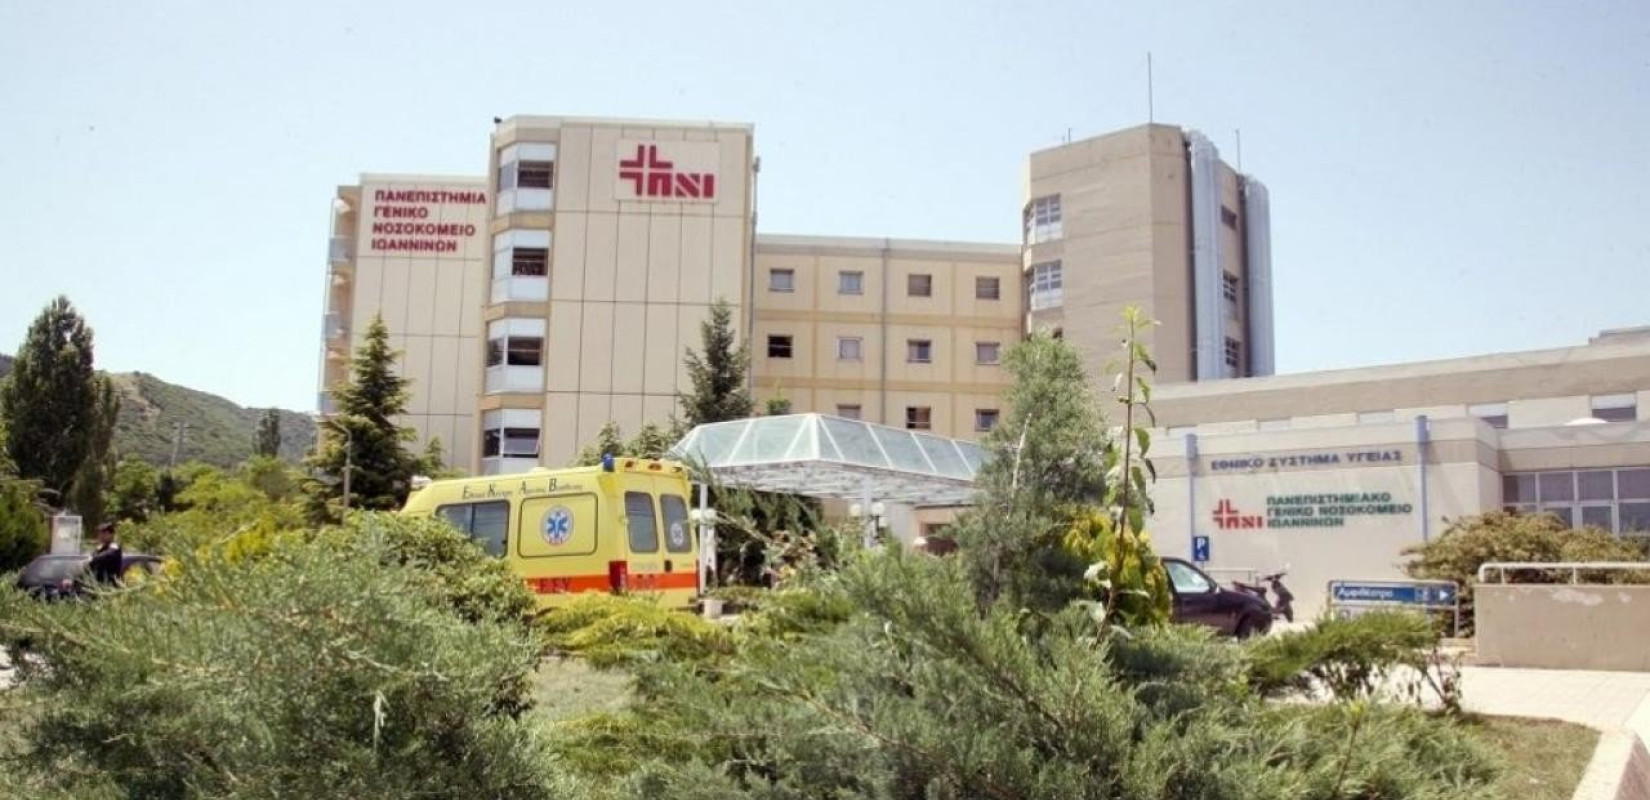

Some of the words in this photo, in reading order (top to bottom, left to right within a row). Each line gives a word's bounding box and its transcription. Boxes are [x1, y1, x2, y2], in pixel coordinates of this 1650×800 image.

[374, 189, 487, 204] ΠΑΝΕΠΙΣΤΗΜΙΑ
[373, 205, 429, 219] ΓΕΝΙΚΟ
[372, 222, 476, 237] ΝΟΣΟΚΟΜΕΙΟ
[371, 238, 457, 252] ΙΩΑΝΝΙΝΩΝ
[1211, 457, 1264, 471] ΕΘΝΙΚΟ
[1268, 454, 1340, 468] ΣΥΣΤΗΜΑ
[1346, 450, 1402, 463] ΥΓΕΙΑΣ
[1266, 492, 1392, 506] ΠΑΝΕΠΙΣΤΗΜΙΑΚΟ
[1266, 506, 1314, 517] ΓΕΝΙΚΟ
[1318, 503, 1413, 516] ΝΟΣΟΚΟΜΕΙΟ
[1267, 516, 1344, 528] ΙΩΑΝΝΙΝΩΝ
